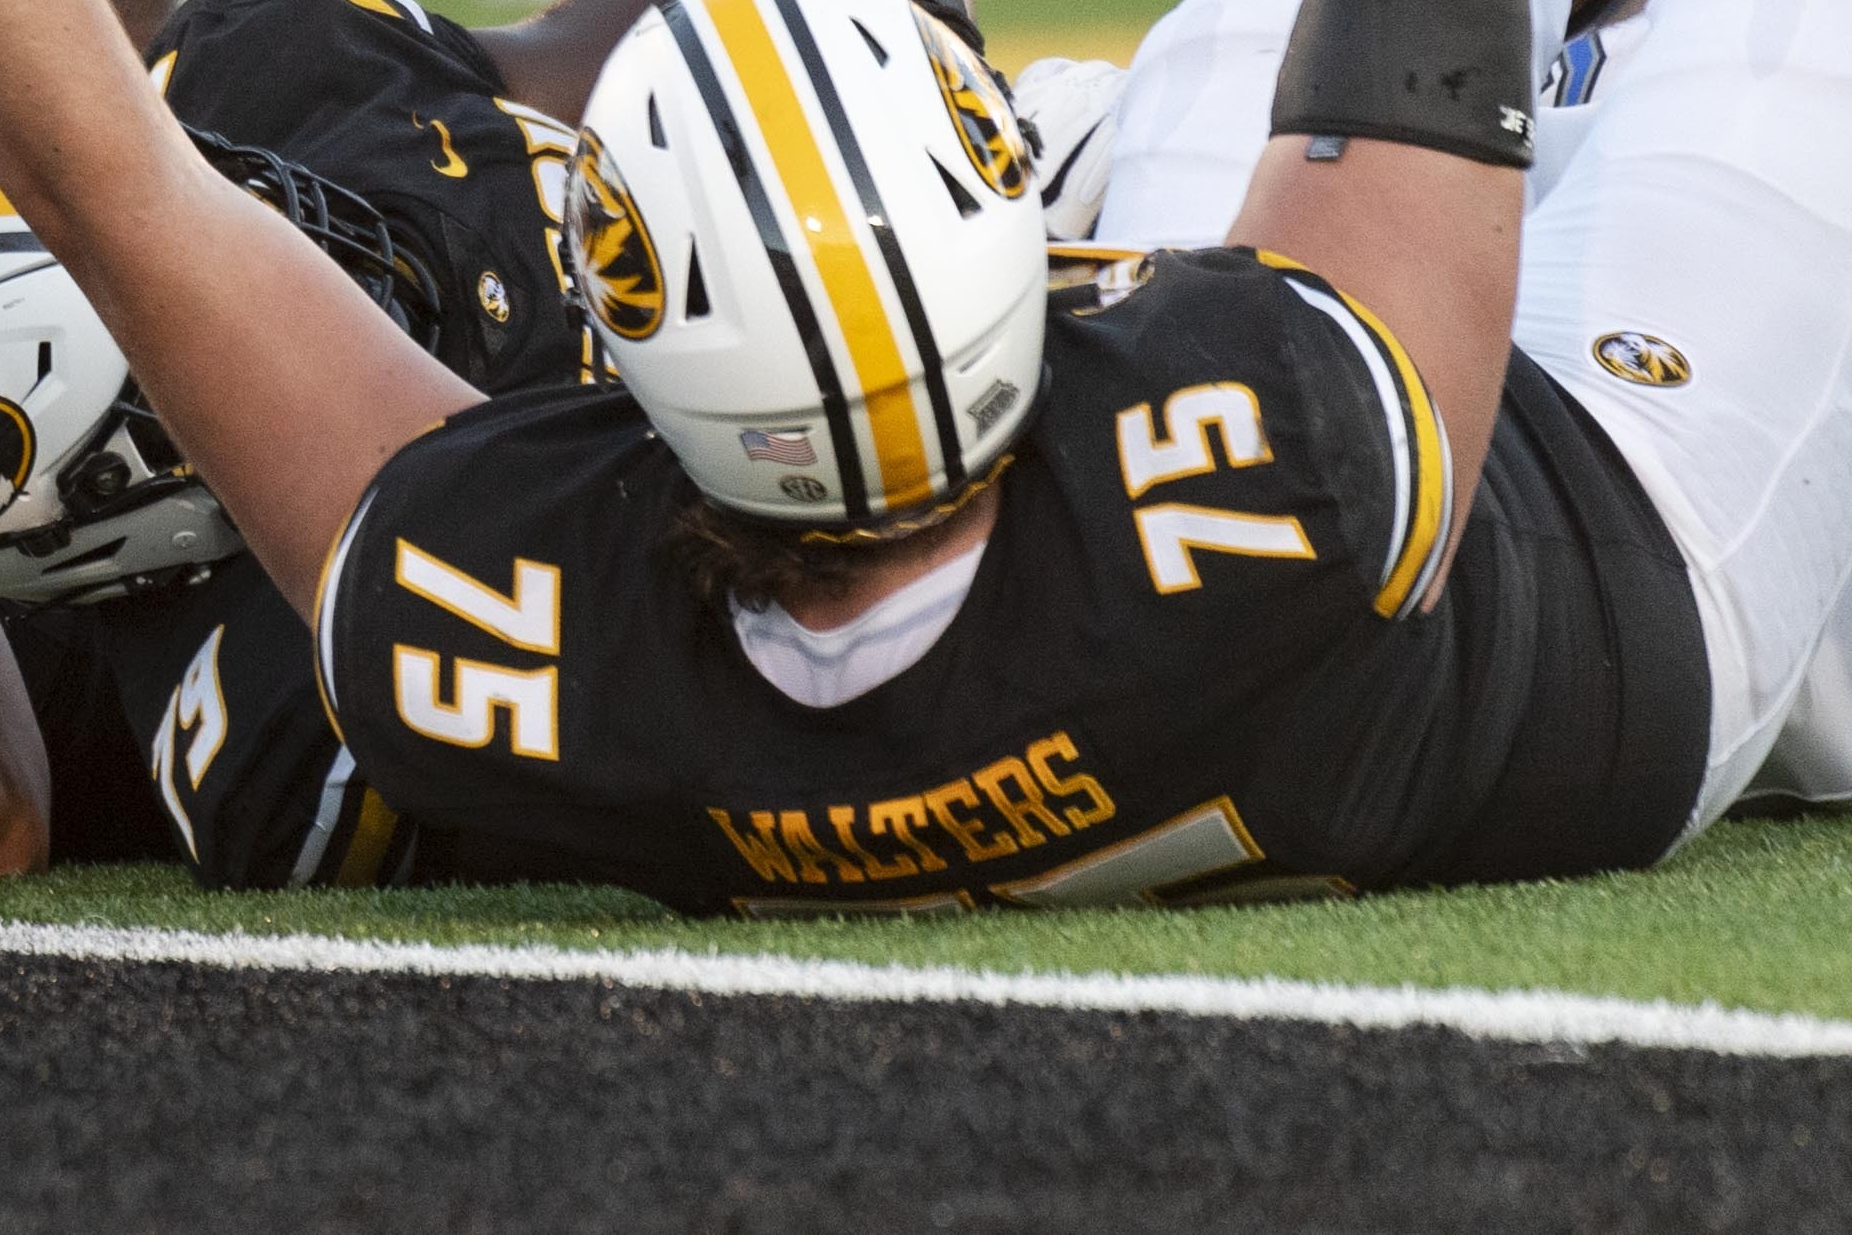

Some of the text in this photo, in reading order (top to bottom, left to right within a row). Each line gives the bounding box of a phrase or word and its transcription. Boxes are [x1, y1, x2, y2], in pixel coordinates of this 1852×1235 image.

[1116, 381, 1318, 596] 75
[393, 536, 561, 762] 75
[707, 731, 1115, 884] WALTERS
